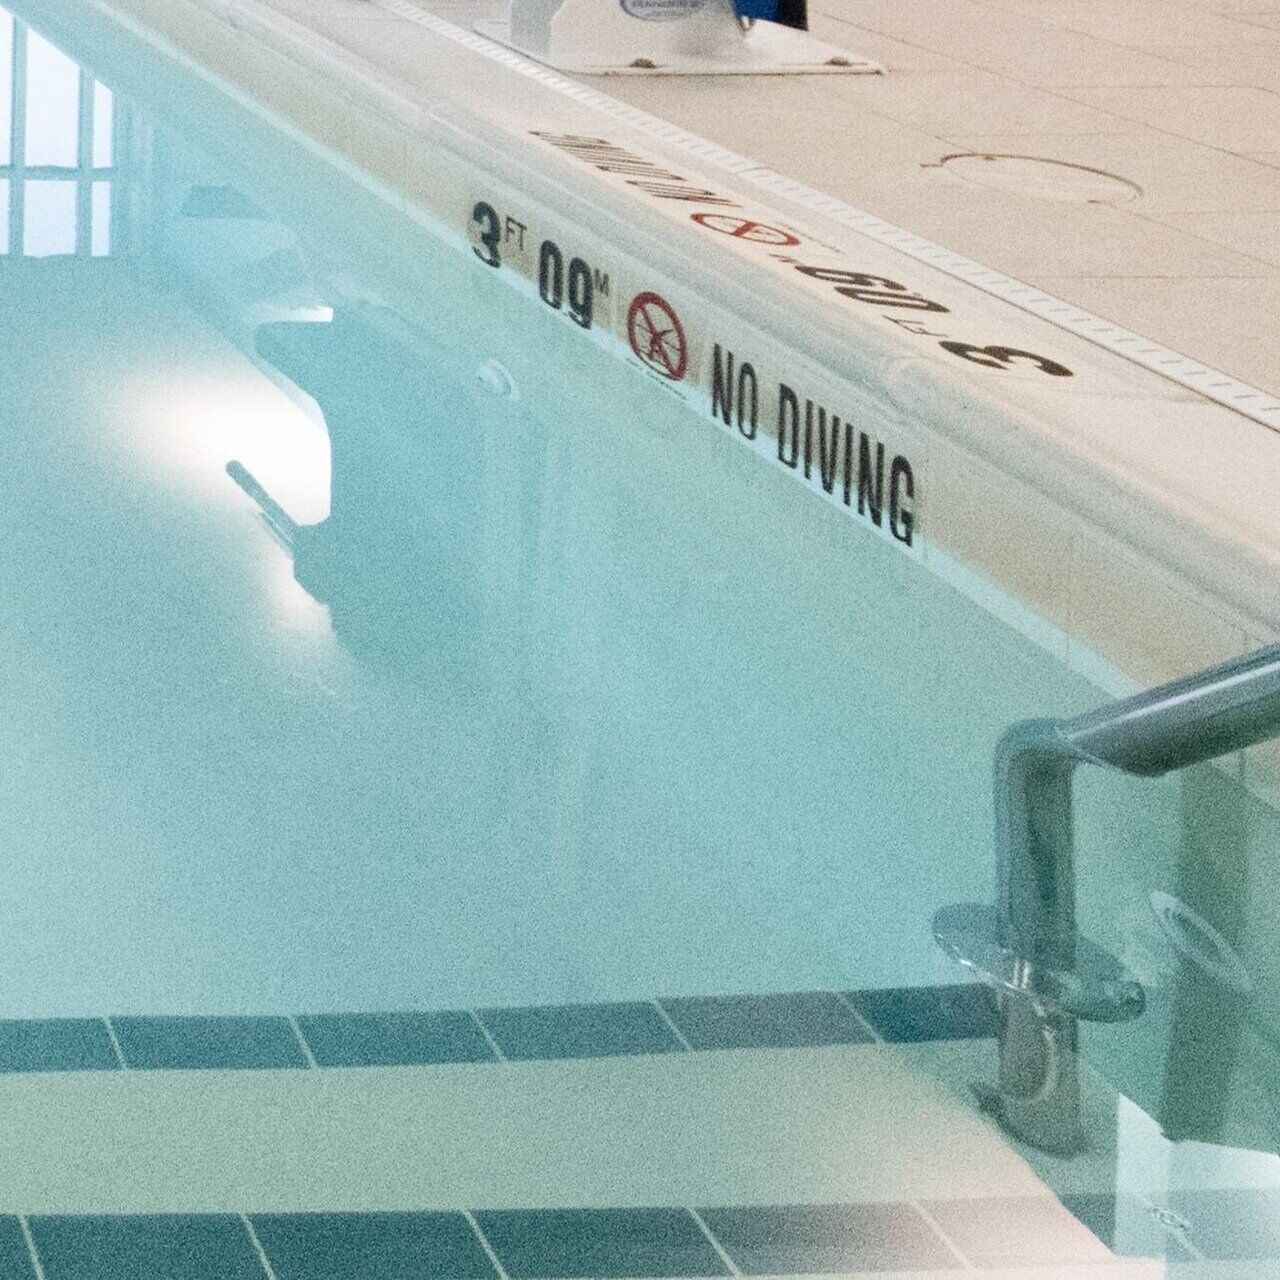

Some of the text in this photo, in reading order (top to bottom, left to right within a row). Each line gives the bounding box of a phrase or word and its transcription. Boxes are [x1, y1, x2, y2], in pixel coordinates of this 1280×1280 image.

[472, 201, 501, 268] 3
[505, 215, 527, 251] FT
[593, 269, 610, 297] M
[711, 343, 759, 441] NO
[778, 383, 915, 547] DIVING
[938, 340, 1074, 377] 3
